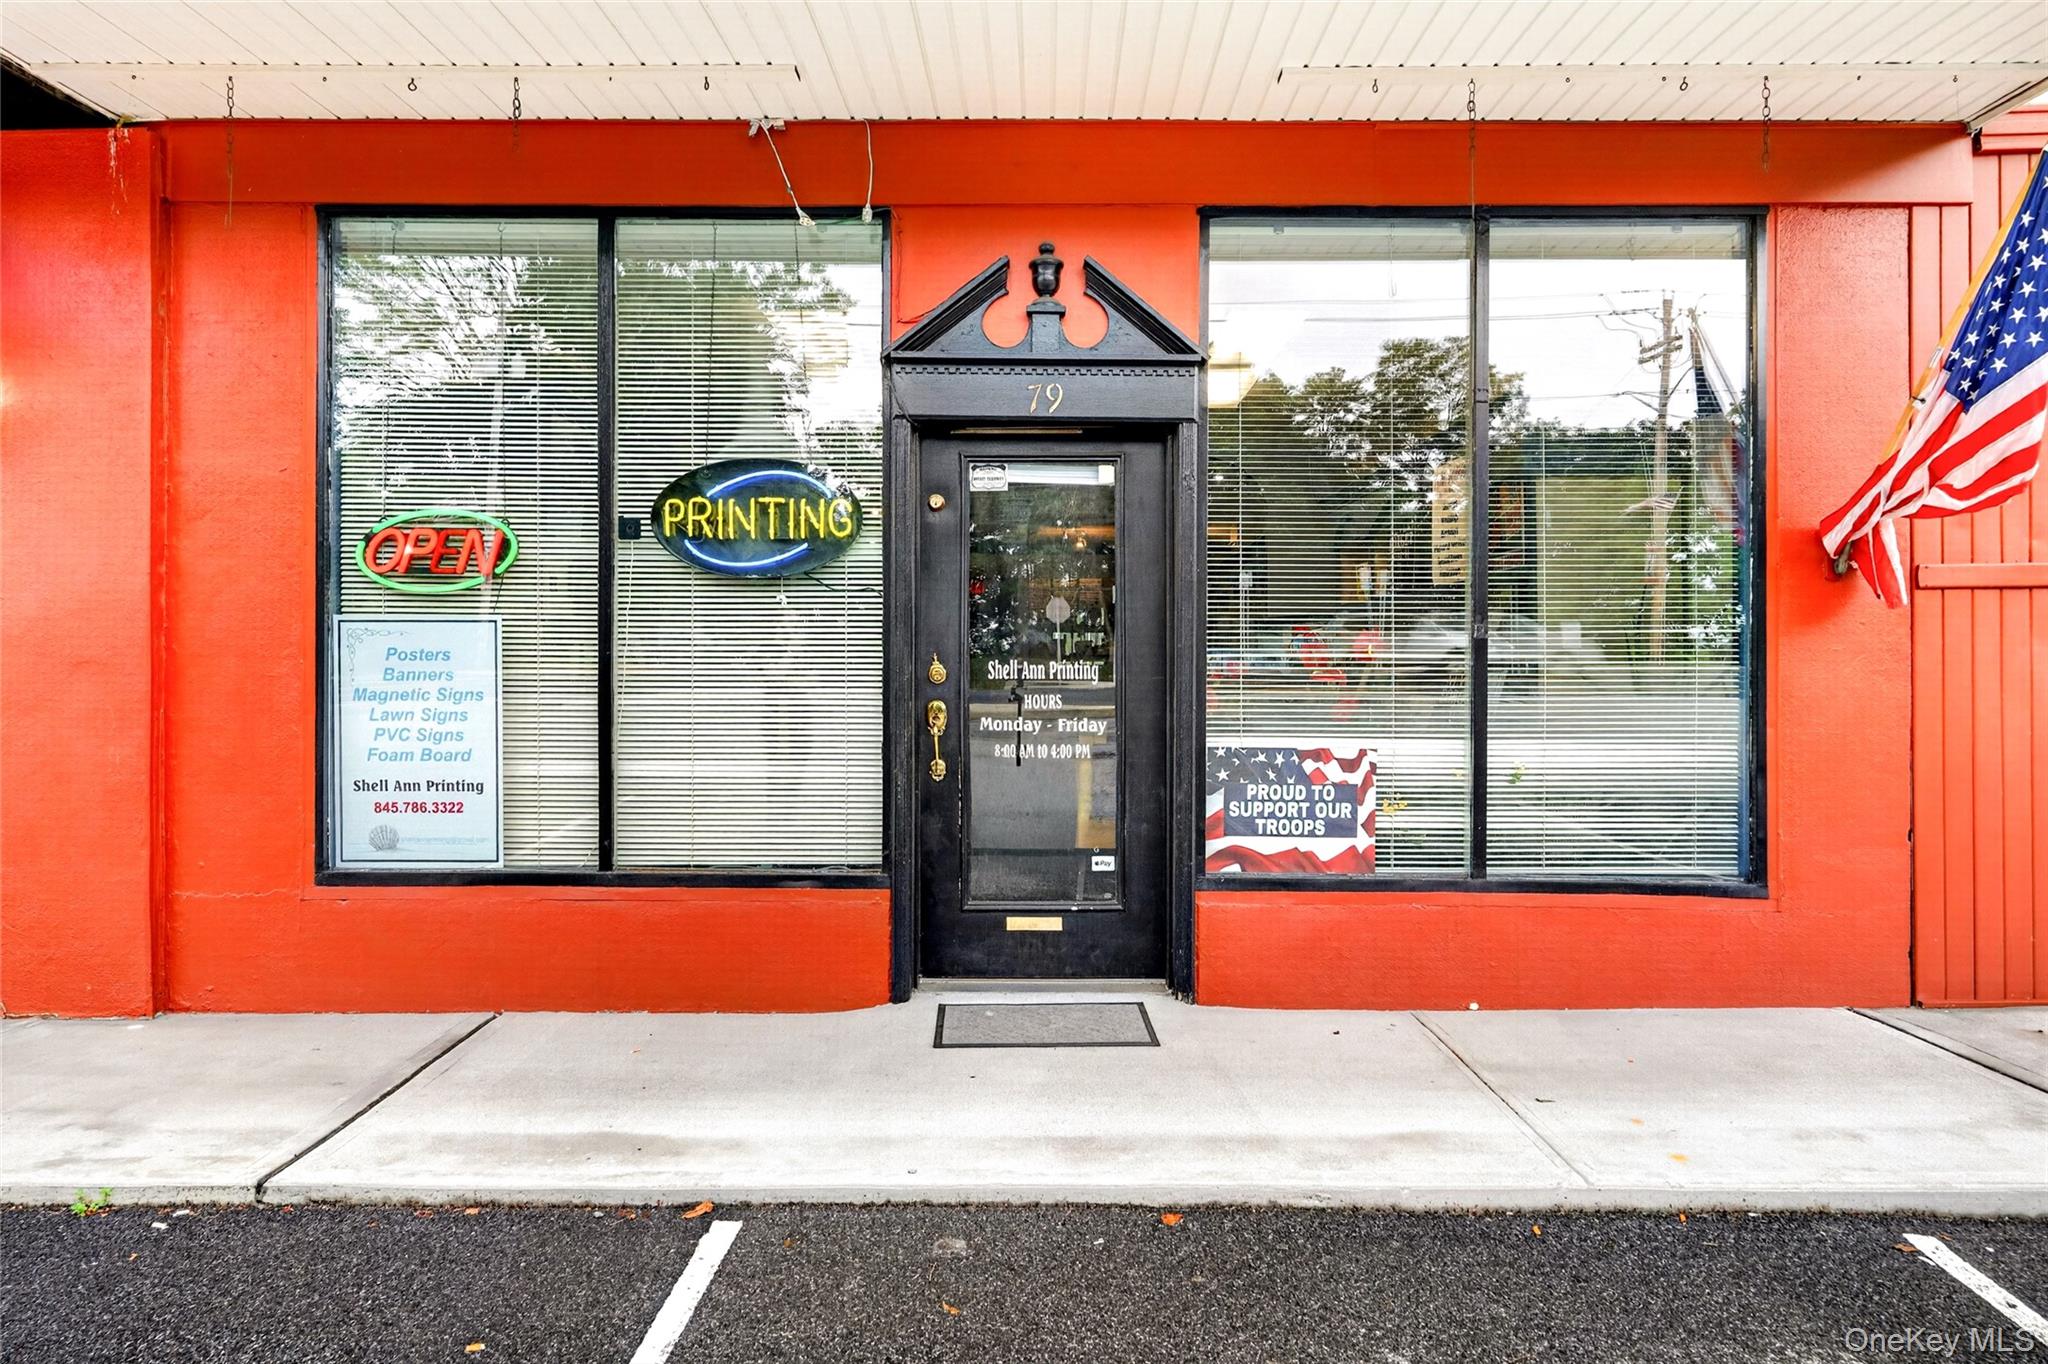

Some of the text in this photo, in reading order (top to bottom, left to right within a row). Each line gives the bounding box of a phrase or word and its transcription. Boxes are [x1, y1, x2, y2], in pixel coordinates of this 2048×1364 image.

[1025, 383, 1063, 414] 79
[663, 496, 853, 540] PRINTING
[365, 527, 505, 576] OPEN
[385, 647, 451, 661] Posters
[383, 667, 454, 681] Banners
[988, 660, 1099, 685] Shell Ann Printing
[352, 687, 484, 705] Magnetic Signs
[1024, 694, 1062, 709] HOURS
[369, 707, 468, 725] Lawn Signs
[980, 717, 1042, 735] Monday
[1058, 717, 1107, 735] Friday
[374, 727, 464, 745] PVC Signs
[367, 747, 472, 762] Foam Board
[994, 744, 1016, 757] 8:00
[1020, 744, 1035, 758] AM
[1050, 744, 1072, 758] 4:00
[1075, 744, 1091, 758] PM
[353, 779, 484, 795] Shell Ann Printing
[1246, 784, 1335, 801] PROUD TO
[374, 802, 464, 814] 845.786.3322
[1229, 801, 1352, 819] SUPPORT OUR
[1255, 818, 1326, 836] TROOPS
